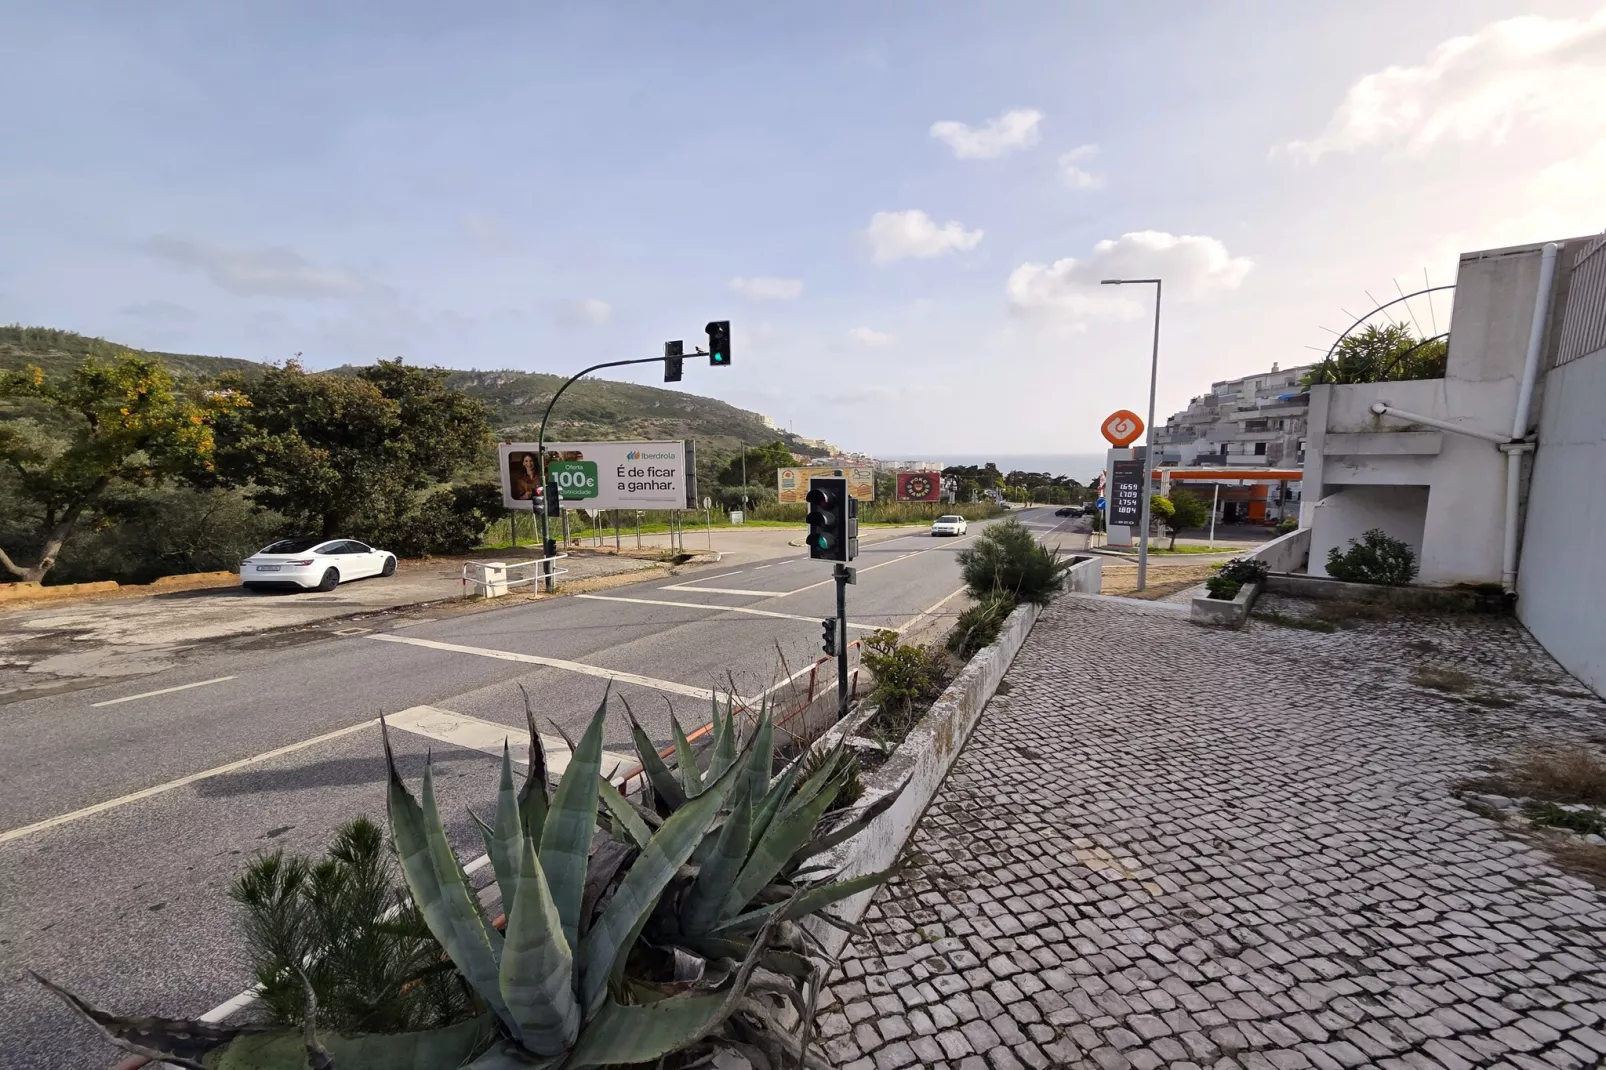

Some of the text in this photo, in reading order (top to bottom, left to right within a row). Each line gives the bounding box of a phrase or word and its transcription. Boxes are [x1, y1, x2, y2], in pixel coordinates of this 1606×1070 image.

[641, 452, 676, 460] Iberdrola
[617, 464, 676, 477] É de ficar
[552, 471, 594, 487] 100€
[617, 480, 676, 493] a ganhar.
